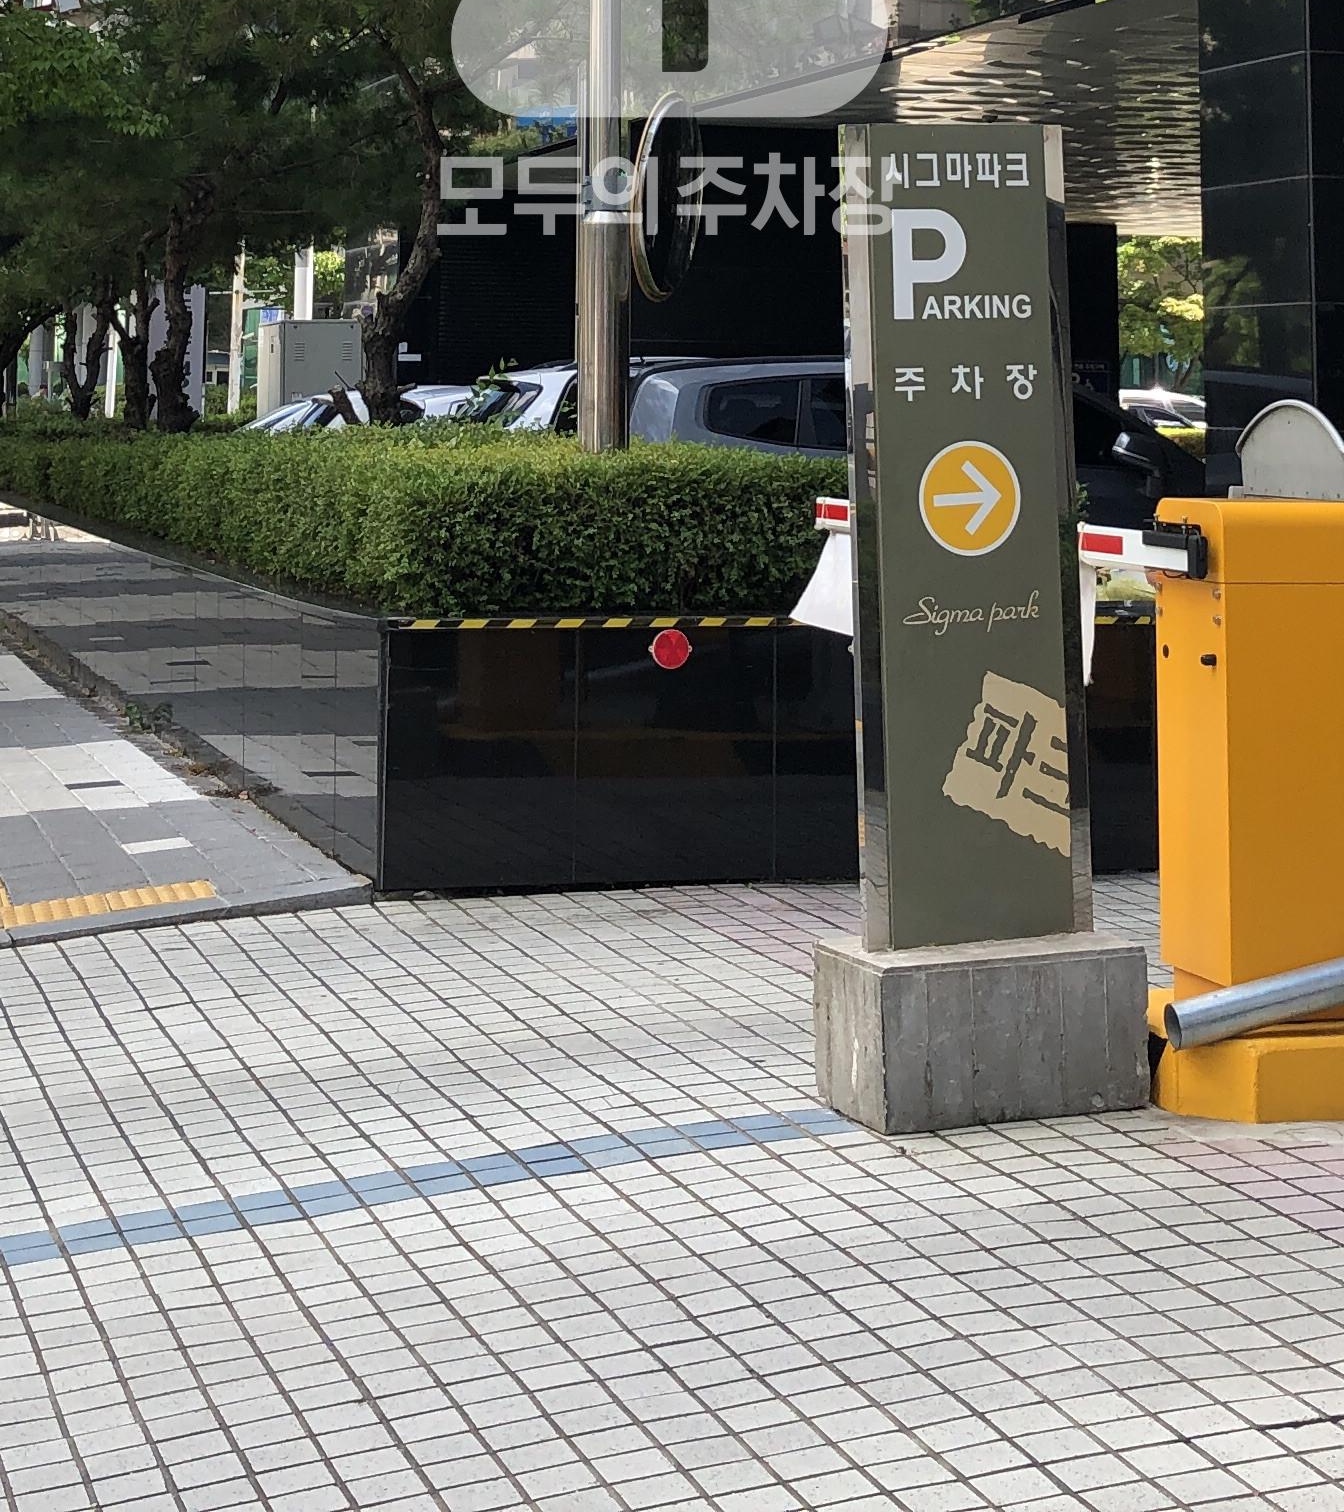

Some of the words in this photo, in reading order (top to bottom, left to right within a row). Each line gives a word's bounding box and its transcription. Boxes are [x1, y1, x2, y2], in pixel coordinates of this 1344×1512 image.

[885, 152, 1030, 189] 시그마파크
[894, 364, 1038, 401] 주차장
[902, 596, 984, 636] Sigma
[987, 590, 1041, 633] park
